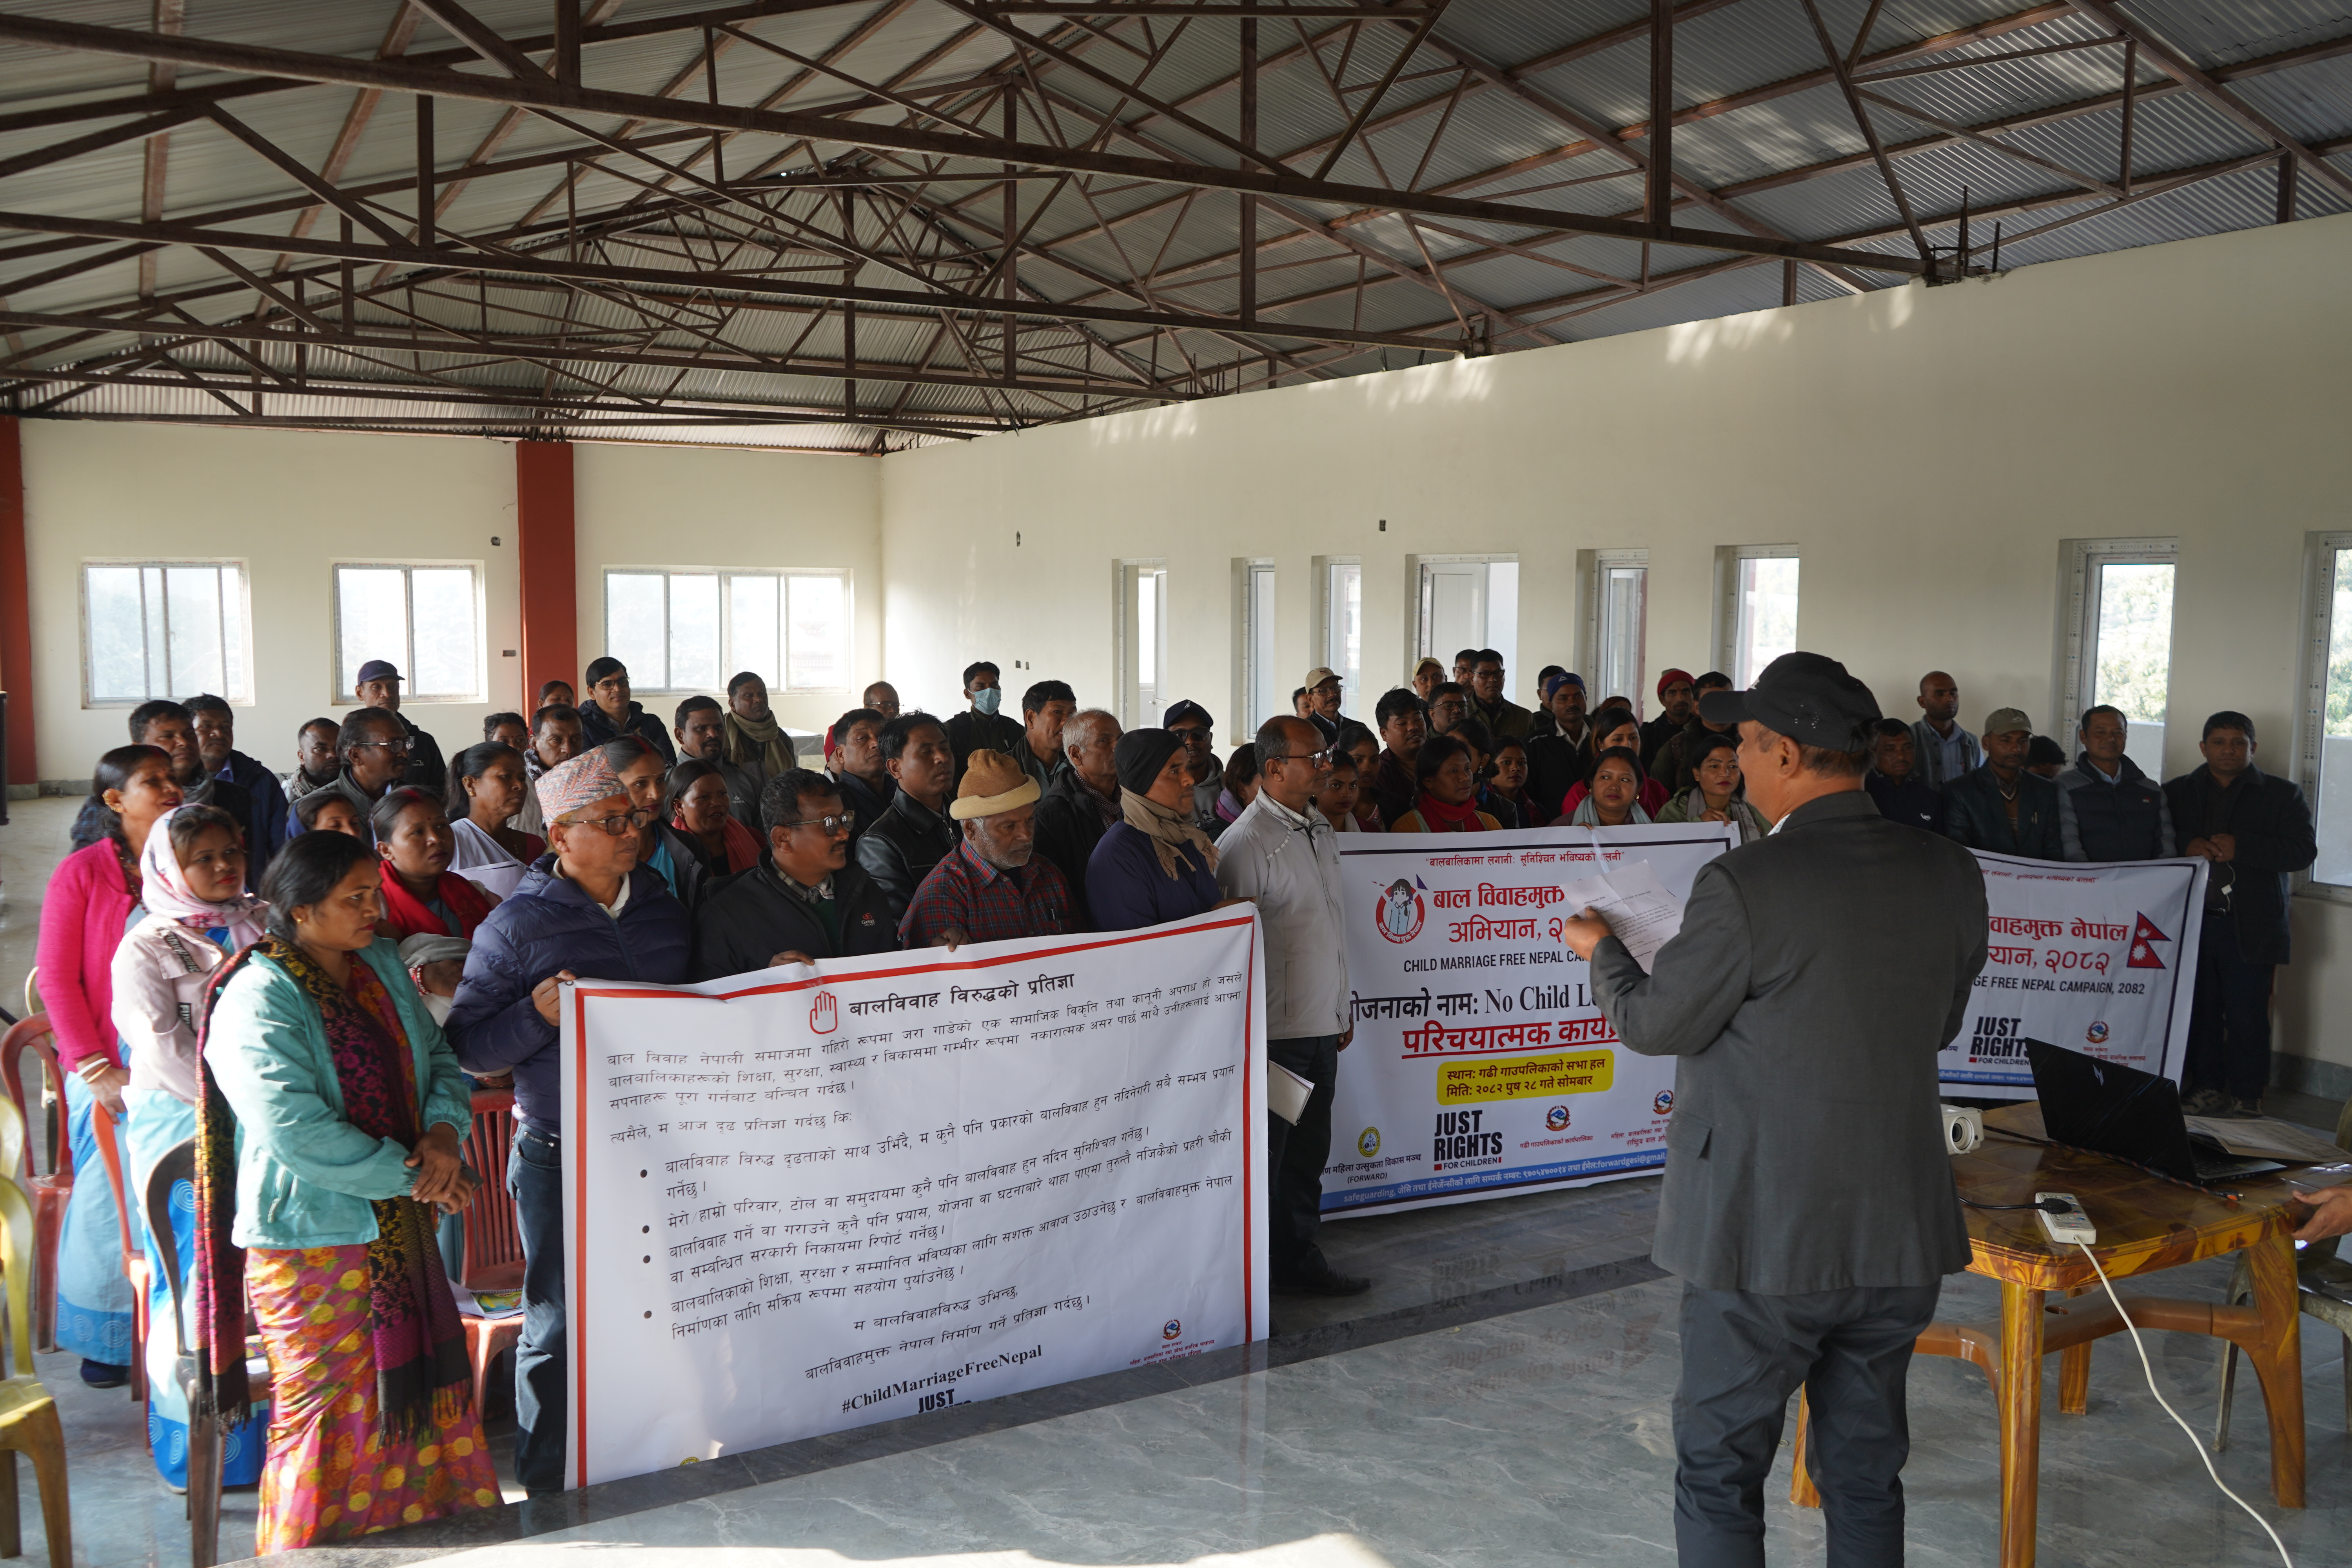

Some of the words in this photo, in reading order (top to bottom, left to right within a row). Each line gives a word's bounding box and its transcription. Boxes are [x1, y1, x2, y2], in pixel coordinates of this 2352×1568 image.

[1520, 852, 1555, 866] सुनिश्चित
[1559, 851, 1595, 862] भविष्यको
[1434, 889, 1471, 908] बाल
[1478, 882, 1565, 909] विवाहमुक्त
[1448, 914, 1541, 943] अभियान,
[1988, 916, 2063, 940] वाहमुक्त
[2070, 917, 2129, 941] नेपाल
[1404, 959, 1437, 972] CHILD
[1440, 955, 1496, 970] MARRIAGE
[1499, 953, 1526, 965] FREE
[1529, 951, 1564, 964] NEPAL
[2045, 949, 2110, 975] २०८२
[848, 992, 941, 1016] बालविवाह
[950, 980, 1019, 1004] विरुद्धको
[1027, 973, 1074, 995] प्रतिज्ञा
[1991, 977, 2018, 989] FREE
[2022, 978, 2056, 991] NEPAL
[2060, 981, 2114, 994] CAMPAIGN,
[2118, 983, 2145, 994] 2082
[1437, 993, 1478, 1016] नाम:
[1485, 988, 1513, 1013] No
[1520, 983, 1570, 1010] Child
[607, 1054, 635, 1065] बाल
[646, 1051, 689, 1064] विवाह
[700, 1051, 744, 1064] नेपाली
[754, 1048, 811, 1061] समाजमा
[821, 1037, 849, 1054] गहिरो
[857, 1033, 893, 1046] रूपमा
[902, 1029, 924, 1040] जरा
[933, 1020, 972, 1035] गाडेको
[982, 1019, 1002, 1031] एक
[1009, 1010, 1060, 1026] सामाजिक
[1067, 1000, 1098, 1017] विकृति
[1105, 998, 1125, 1009] तथा
[1132, 988, 1162, 1005] कानूनी
[1169, 983, 1197, 996] अपराध
[1202, 977, 1211, 989] हो
[1217, 971, 1242, 985] जसले
[1974, 1016, 2022, 1036] JUST
[608, 1070, 730, 1087] बालबालिकाहरूको
[737, 1071, 775, 1083] शिक्षा,
[783, 1067, 822, 1083] सुरक्षा,
[829, 1057, 866, 1073] स्वास्थ्य
[871, 1055, 878, 1064] र
[884, 1046, 938, 1063] विकासमा
[943, 1038, 980, 1053] गम्भीर
[985, 1035, 1020, 1047] रूपमा
[1030, 1024, 1085, 1041] नकारात्मक
[1091, 1018, 1113, 1030] असर
[1117, 1010, 1136, 1024] पार्छ
[1141, 1006, 1160, 1020] साथै
[1163, 993, 1210, 1015] उनीहरूलाई
[1214, 991, 1241, 1002] आफ्ना
[1402, 1020, 1552, 1053] परिचयात्मक
[1447, 1070, 1475, 1080] स्थान:
[1479, 1065, 1498, 1078] गढी
[1566, 1060, 1588, 1070] सभा
[1590, 1058, 1606, 1071] हल
[1447, 1085, 1472, 1097] मिति:
[1476, 1083, 1502, 1094] २०८२
[1506, 1081, 1521, 1095] पुष
[1524, 1080, 1537, 1090] २८
[1540, 1076, 1555, 1089] गते
[1557, 1075, 1593, 1087] सोमबार
[665, 1153, 730, 1173] बालविवाह
[739, 1151, 775, 1166] विरुद्ध
[784, 1147, 836, 1168] दृढताको
[844, 1145, 870, 1158] साथ
[919, 1132, 929, 1143] म
[936, 1123, 956, 1144] कुनै
[962, 1119, 984, 1135] पनि
[990, 1110, 1033, 1131] प्रकारको
[1040, 1100, 1089, 1120] बालविवाह
[1094, 1096, 1108, 1111] हुन
[1114, 1081, 1151, 1102] नदिनेगरी
[1156, 1074, 1172, 1089] सबै
[1177, 1072, 1207, 1085] सम्भव
[1212, 1065, 1235, 1079] प्रयास
[1434, 1110, 1483, 1137] JUST
[1434, 1132, 1503, 1161] RIGHTS
[1333, 1163, 1354, 1174] महिला
[1356, 1160, 1384, 1172] उत्सुकता
[1385, 1156, 1405, 1167] विकास
[1443, 1162, 1459, 1170] FOR
[1460, 1157, 1498, 1168] CHILDREN
[1343, 1189, 1396, 1202] safeguarding,
[1465, 1175, 1480, 1185] लागि
[1568, 1163, 1581, 1172] तथा
[1347, 1172, 1387, 1184] (FORWARD)
[671, 1278, 754, 1313] बालबालिकाको
[759, 1272, 792, 1290] शिक्षा,
[799, 1268, 836, 1283] सुरक्षा
[842, 1266, 849, 1276] र
[855, 1255, 912, 1274] सम्मानित
[917, 1243, 967, 1263] भविष्यका
[972, 1234, 998, 1250] लागि
[1002, 1226, 1034, 1243] सशक्त
[1039, 1214, 1069, 1231] आवाज
[1073, 1201, 1116, 1221] उठाउनेछु
[1120, 1199, 1127, 1209] र
[1136, 1181, 1201, 1205] बालविवाहमुक्त
[1205, 1175, 1233, 1189] नेपाल
[805, 1346, 892, 1379] बालविवाहमुक्त
[899, 1337, 935, 1351] नेपाल
[942, 1324, 982, 1343] निर्माण
[988, 1314, 1007, 1330] गर्ने
[1013, 1305, 1048, 1324] प्रतिज्ञा
[1054, 1295, 1082, 1311] गर्दछु
[842, 1345, 1042, 1414] #ChildMarriageFreeNepal
[918, 1389, 955, 1414] JUST
